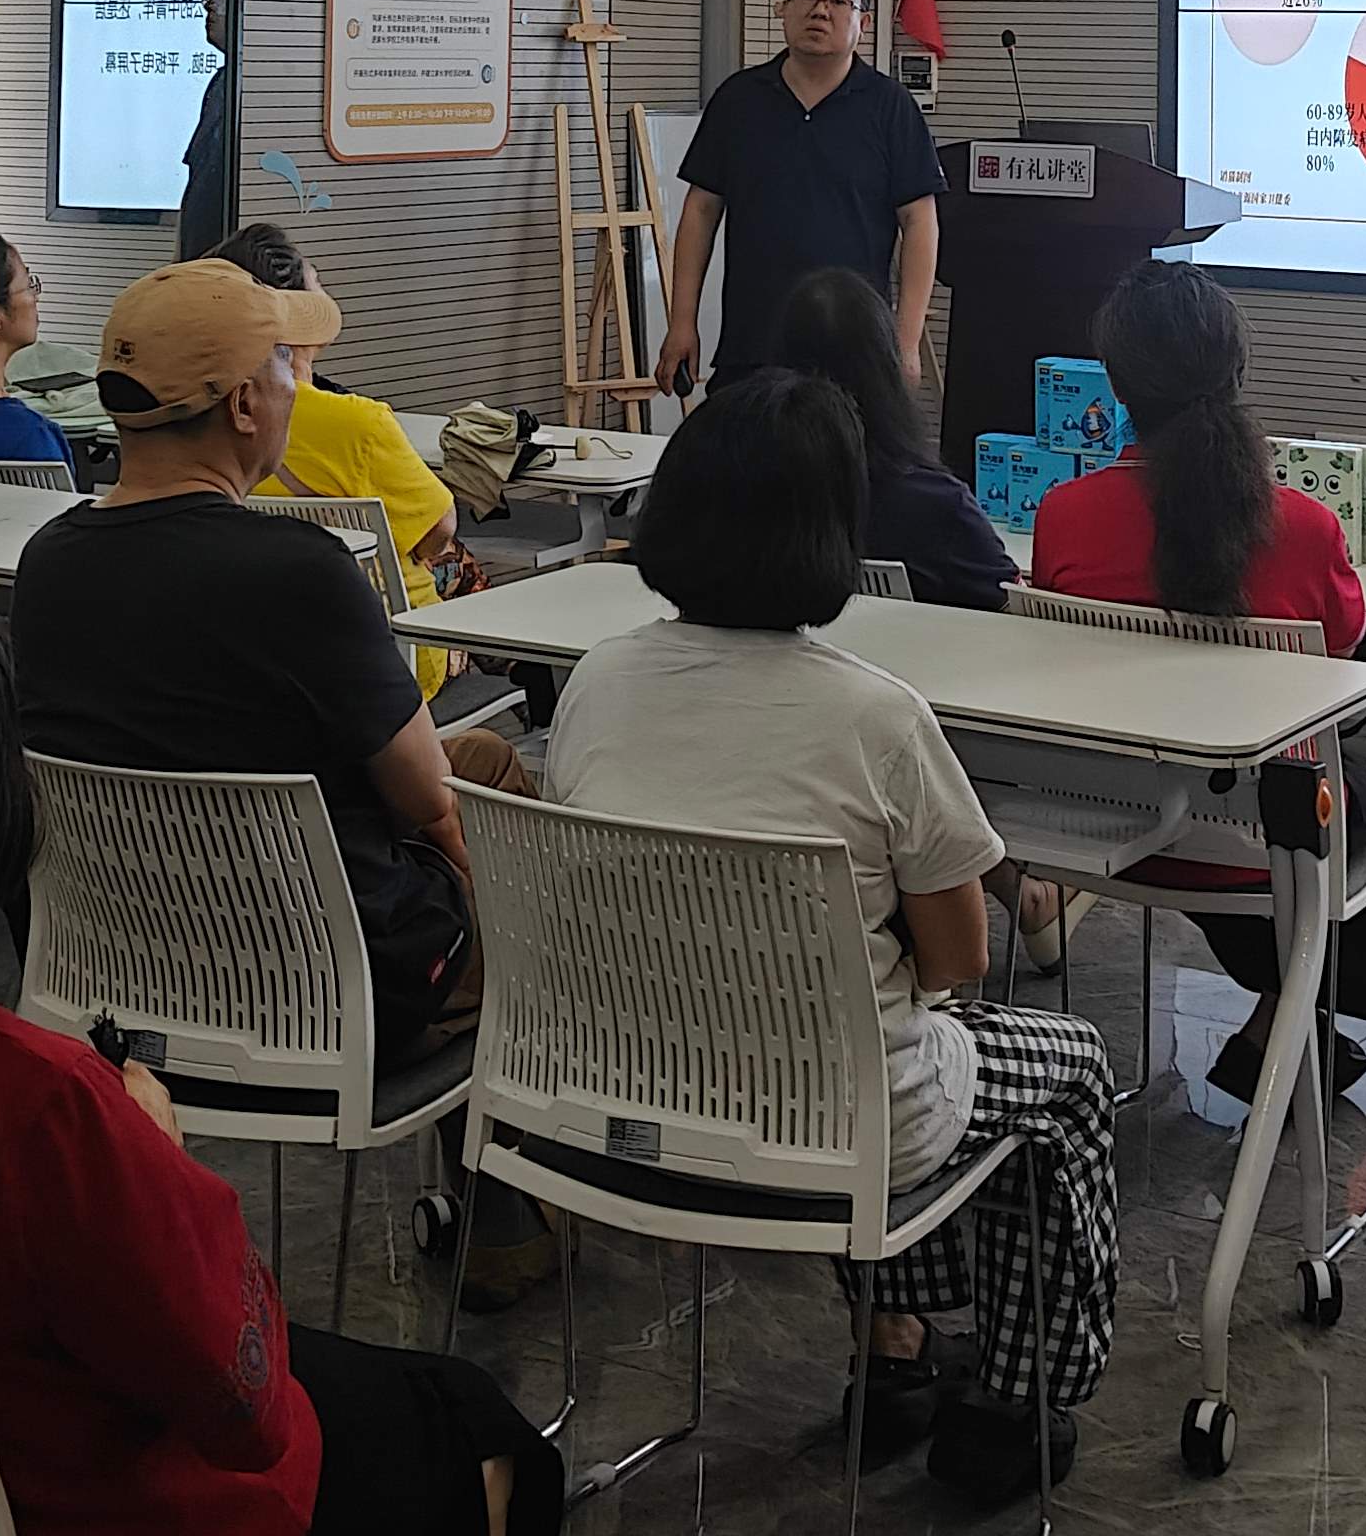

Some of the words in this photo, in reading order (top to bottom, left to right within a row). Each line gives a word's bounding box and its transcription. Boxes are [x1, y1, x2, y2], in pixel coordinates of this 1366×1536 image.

[1005, 156, 1087, 183] 有礼讲堂
[1306, 154, 1335, 172] 80%
